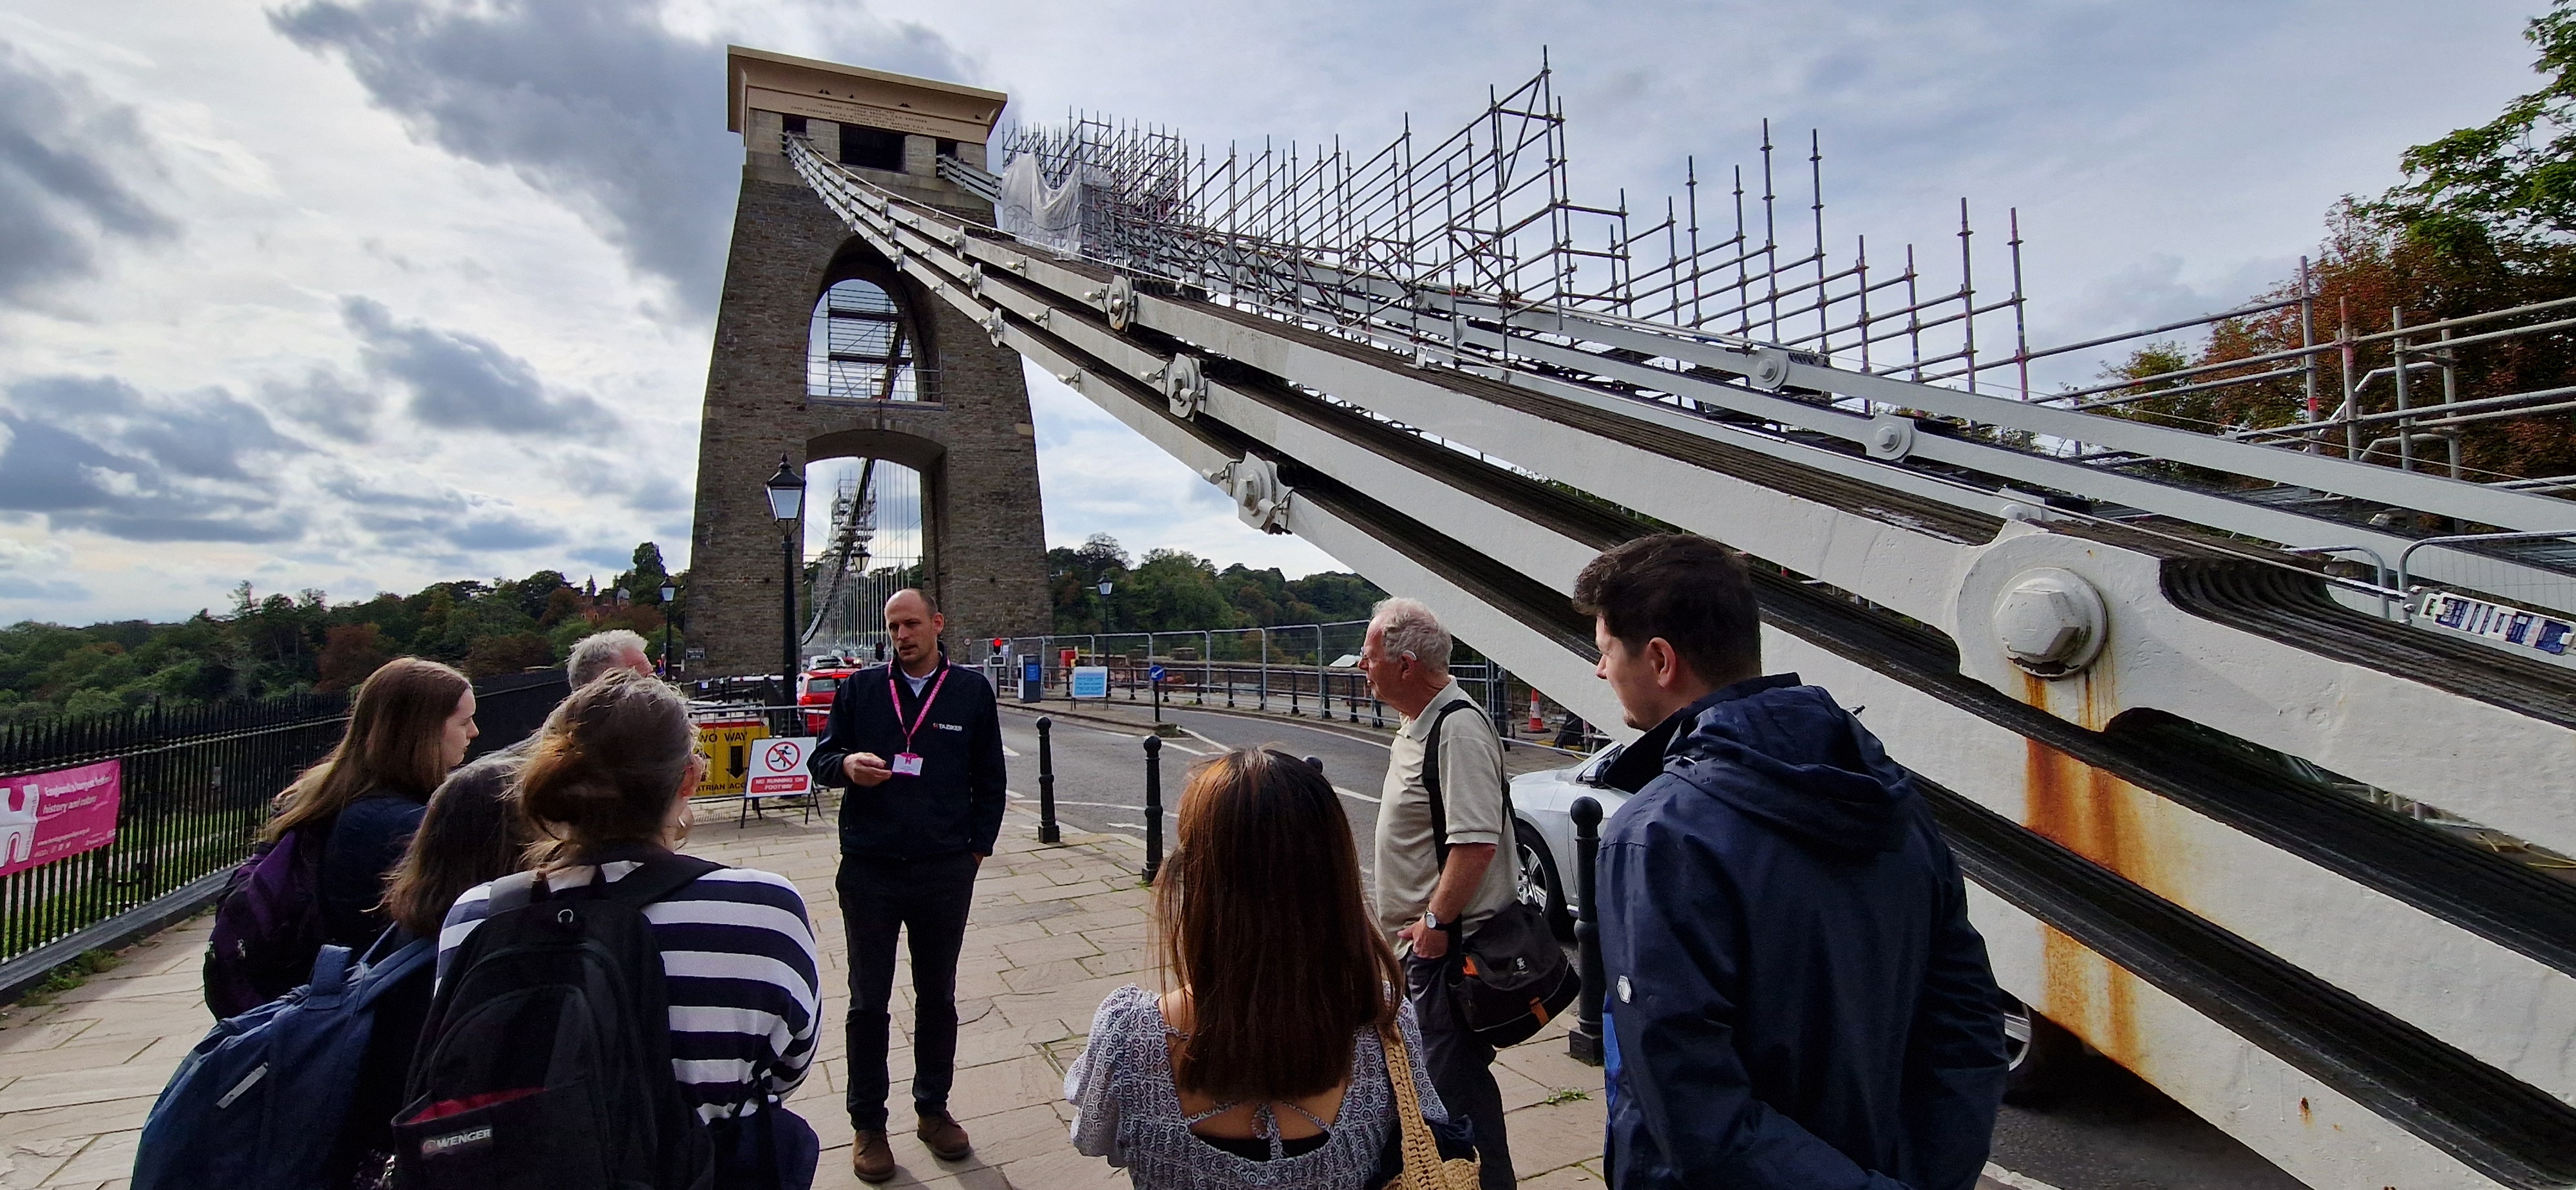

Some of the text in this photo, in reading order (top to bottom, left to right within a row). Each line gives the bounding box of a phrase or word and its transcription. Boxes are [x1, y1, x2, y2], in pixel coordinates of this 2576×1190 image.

[700, 732, 747, 742] WO WAY
[437, 1128, 491, 1148] WENGER
